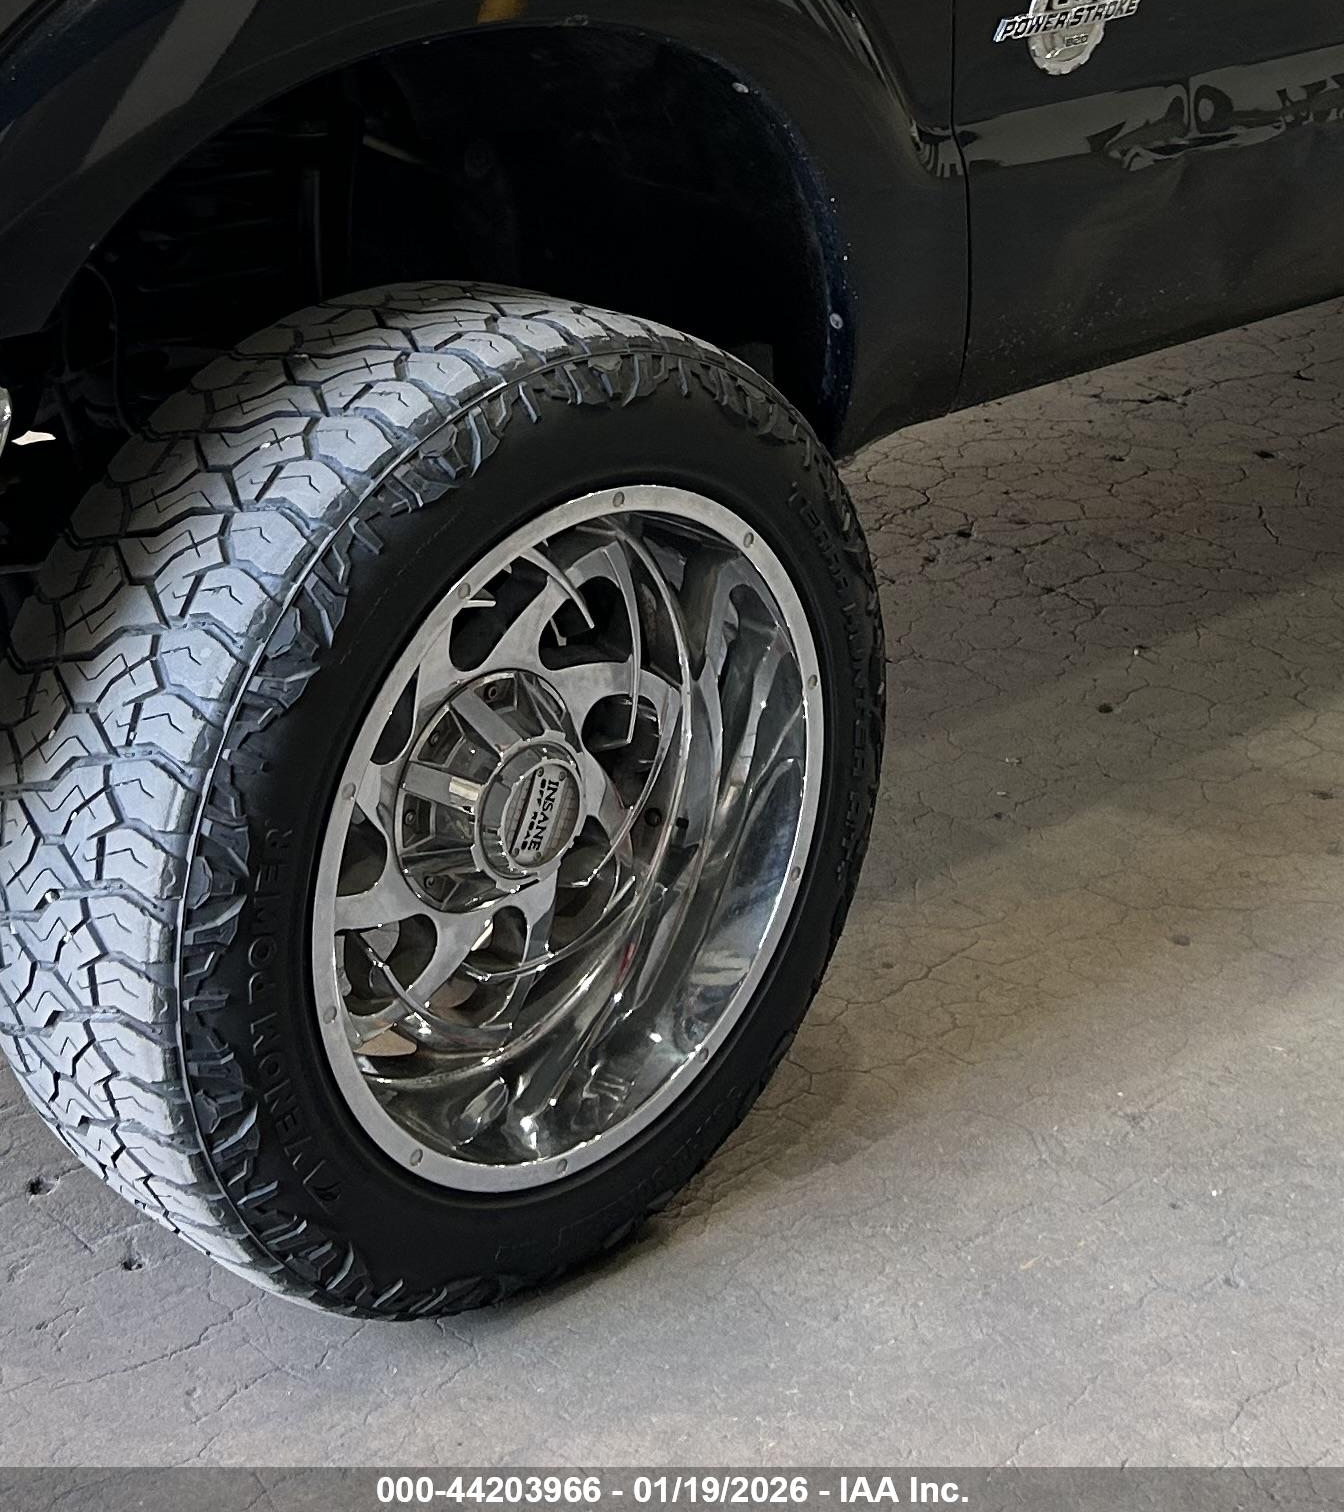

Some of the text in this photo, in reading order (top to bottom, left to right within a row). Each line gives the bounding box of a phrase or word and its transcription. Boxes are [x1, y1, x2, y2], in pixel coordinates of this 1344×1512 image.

[521, 778, 547, 851] OFF ROAD
[527, 779, 560, 851] INSANE
[247, 825, 313, 1173] VENOM POWER
